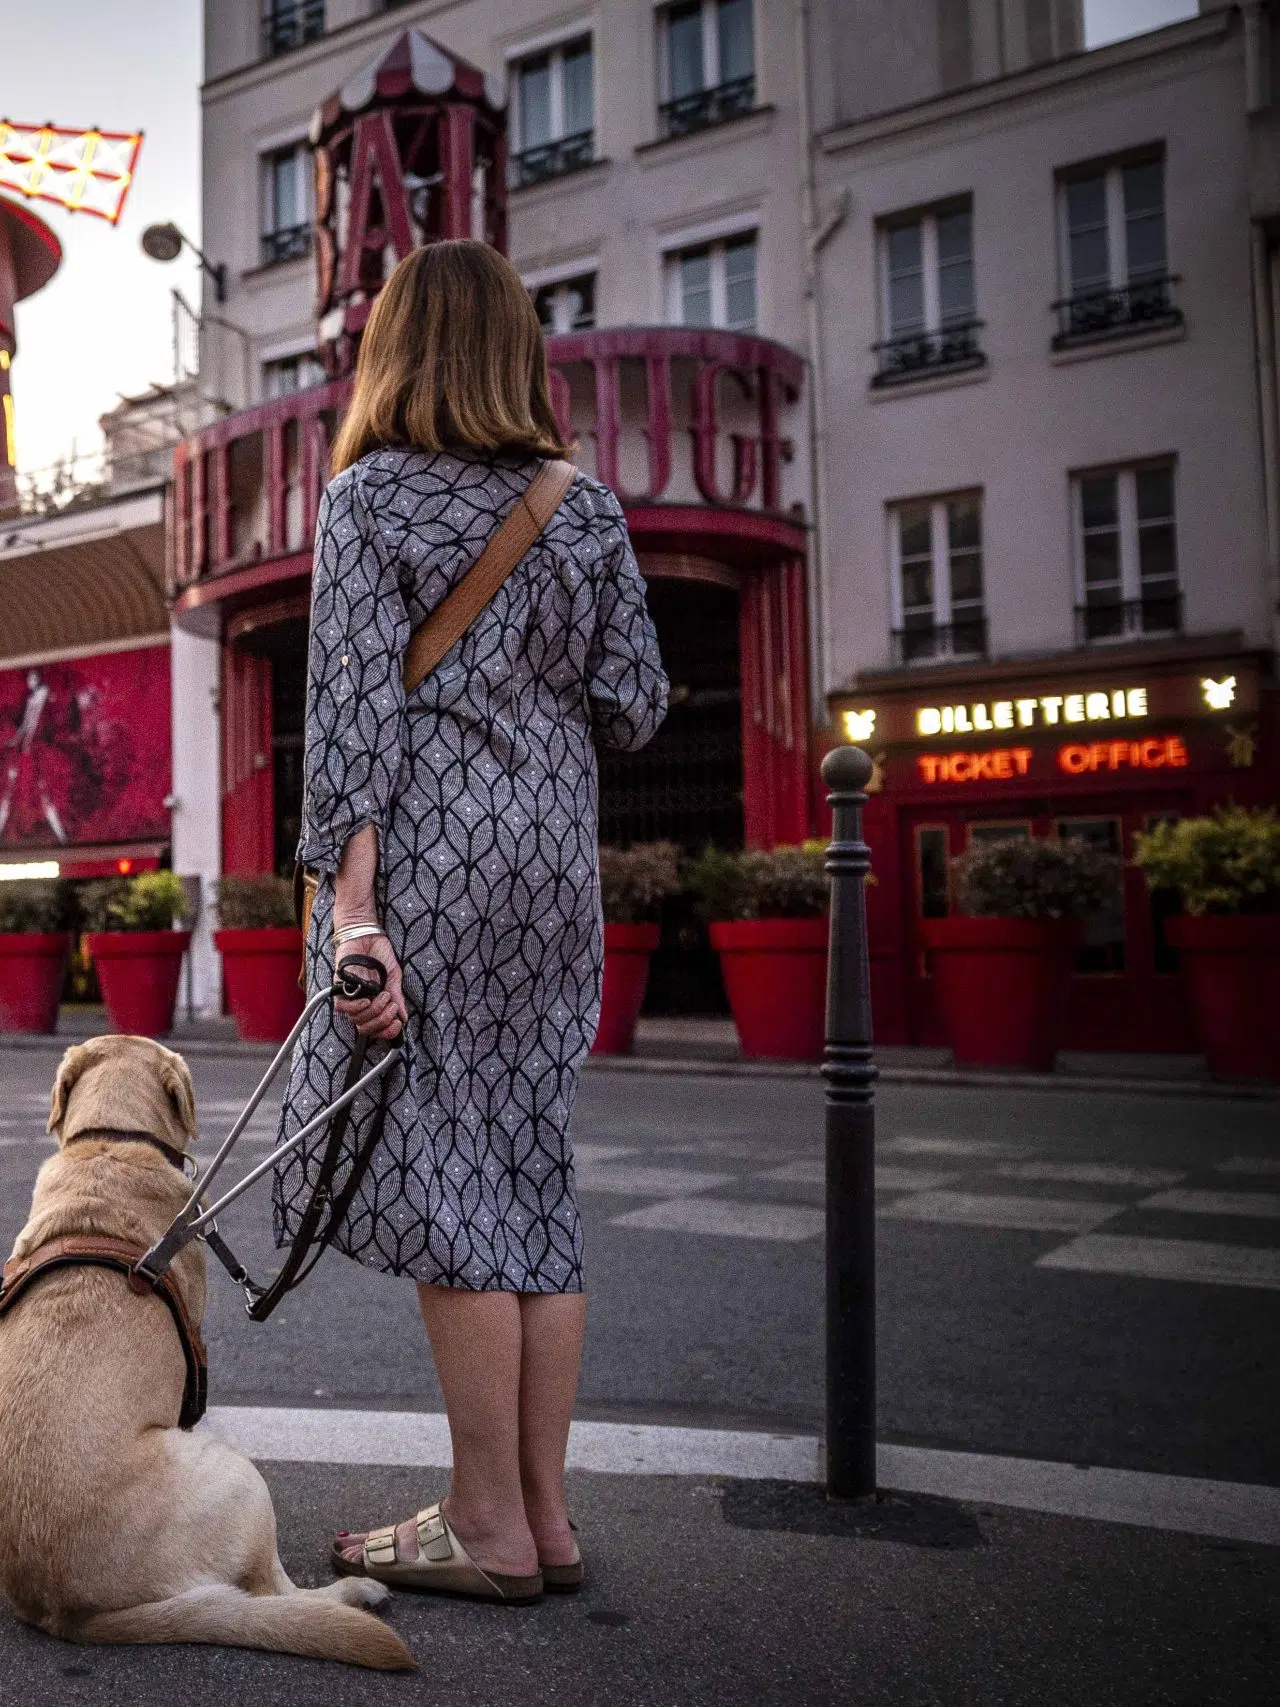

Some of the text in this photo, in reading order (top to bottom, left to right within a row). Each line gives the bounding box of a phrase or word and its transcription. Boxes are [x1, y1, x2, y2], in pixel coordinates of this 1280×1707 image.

[917, 688, 1148, 736] BILLETTERIE
[918, 736, 1189, 784] TICKET OFFICE
